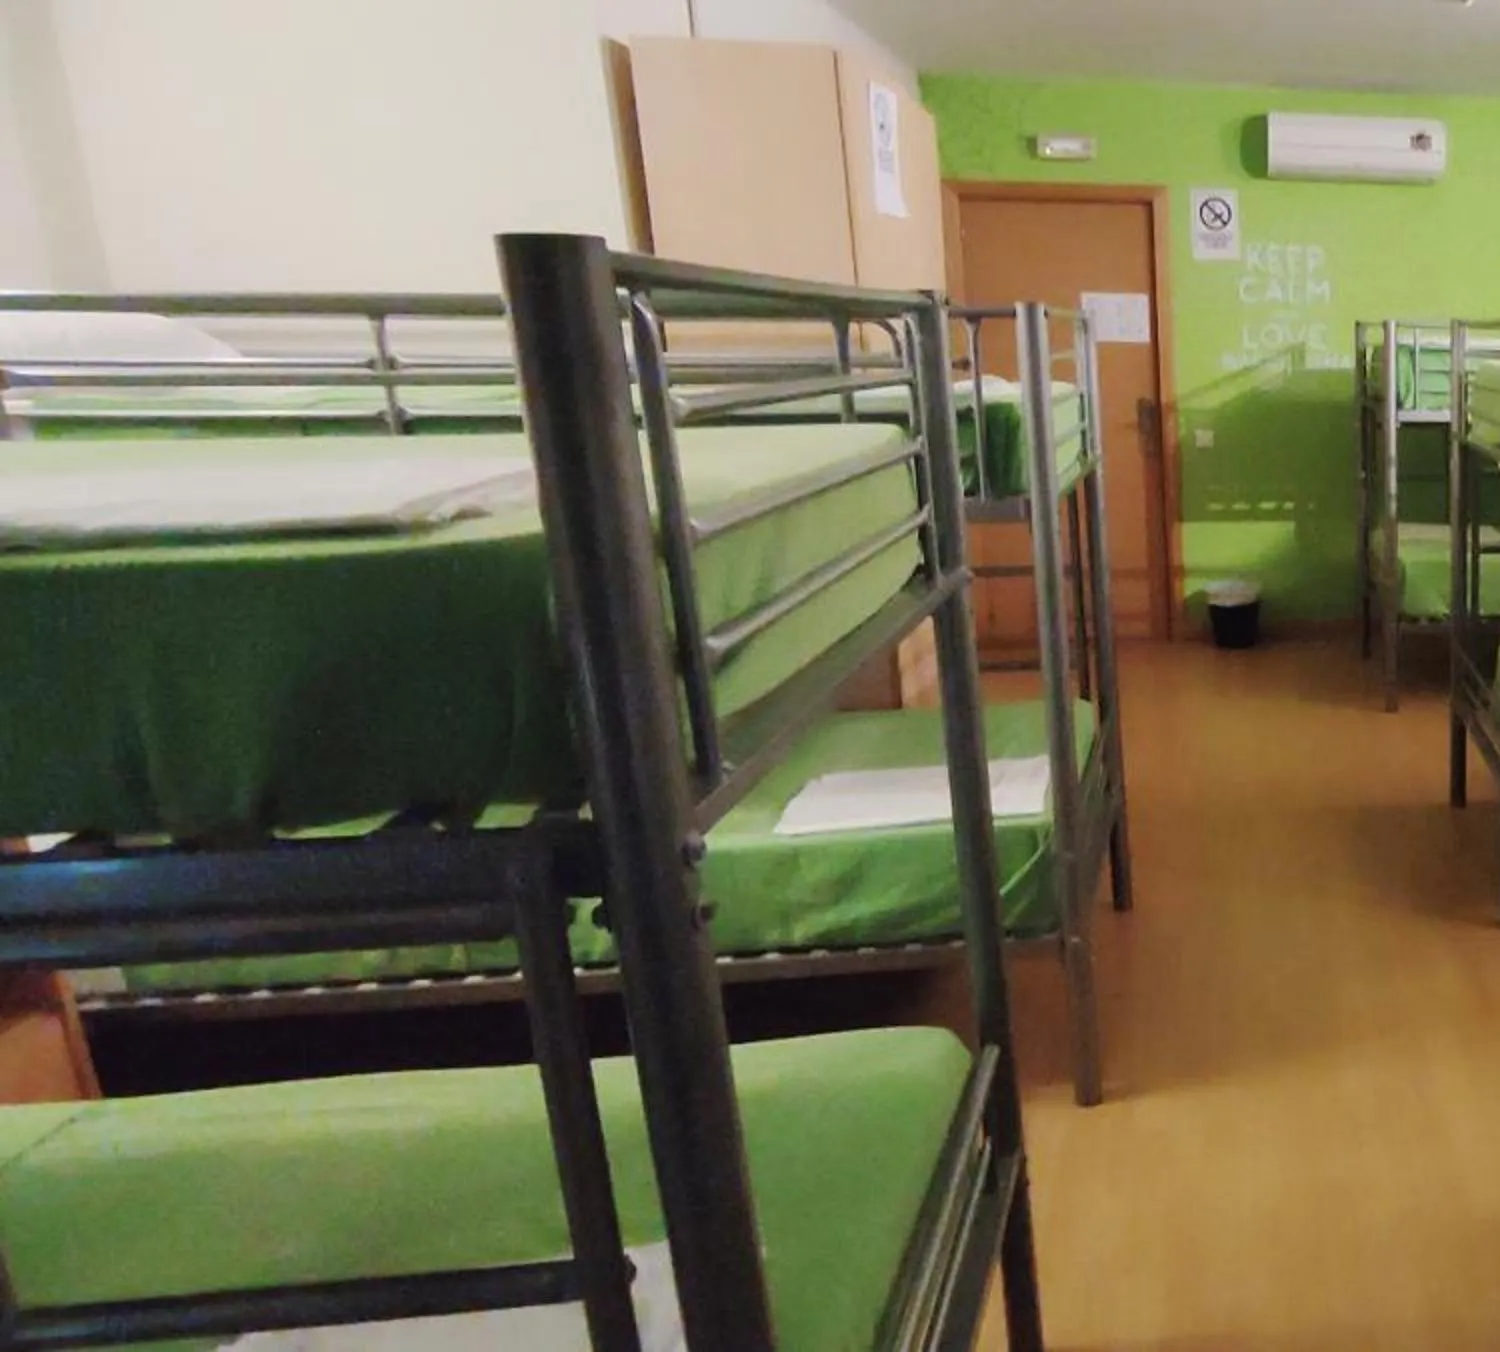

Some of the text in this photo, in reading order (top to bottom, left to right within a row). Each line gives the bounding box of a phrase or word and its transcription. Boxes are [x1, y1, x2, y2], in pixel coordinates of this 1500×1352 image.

[1246, 244, 1324, 273] KEEP
[1239, 275, 1331, 304] CALM
[1243, 322, 1328, 350] LOVE
